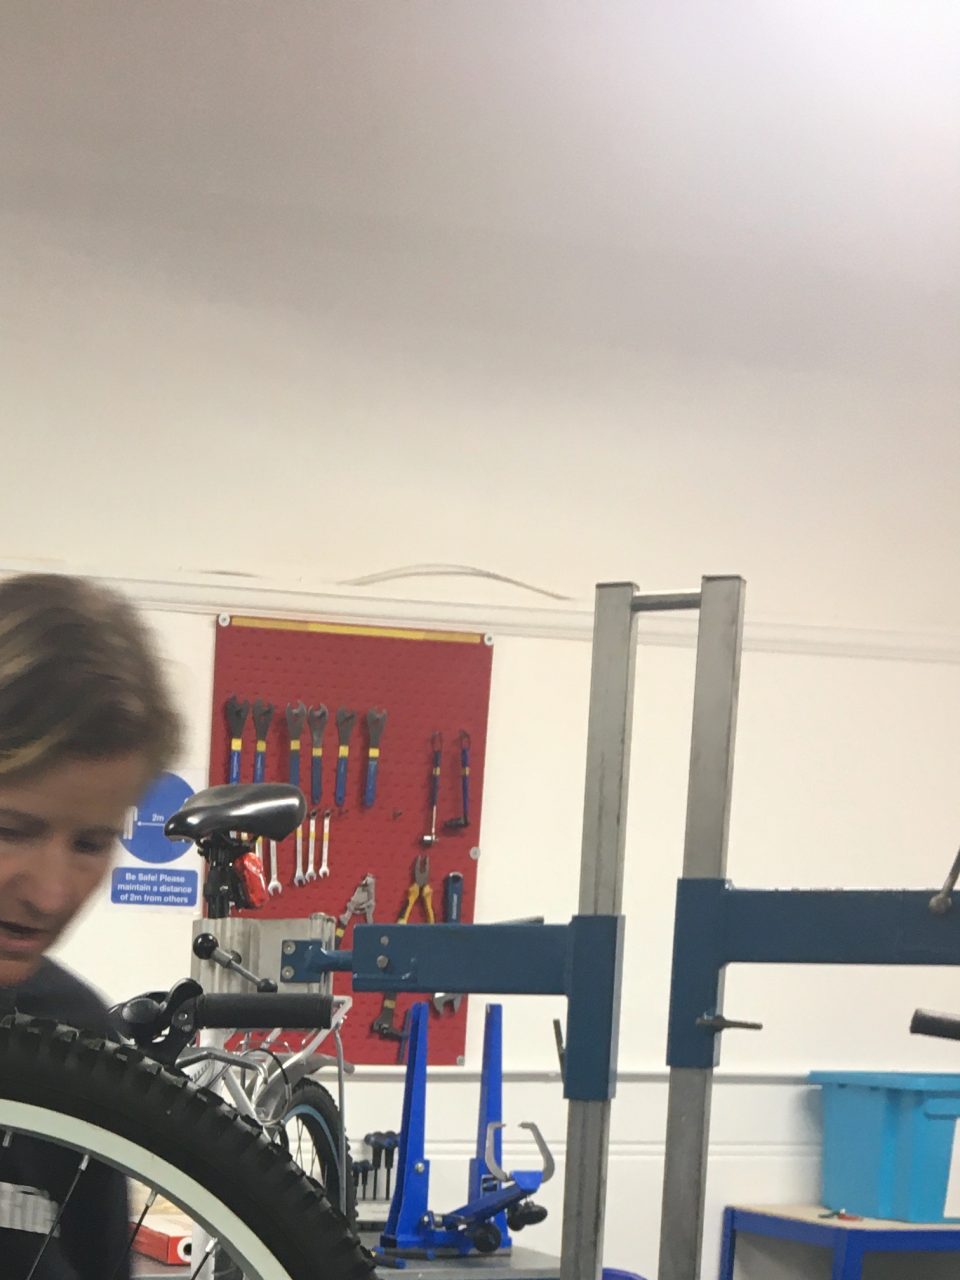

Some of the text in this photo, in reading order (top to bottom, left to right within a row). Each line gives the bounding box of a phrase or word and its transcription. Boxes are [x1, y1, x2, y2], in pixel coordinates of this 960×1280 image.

[152, 813, 165, 822] 2m
[125, 872, 185, 883] Be Safe! Please
[117, 883, 151, 892] maintain
[159, 885, 192, 894] distance
[120, 893, 189, 904] of 2m from others
